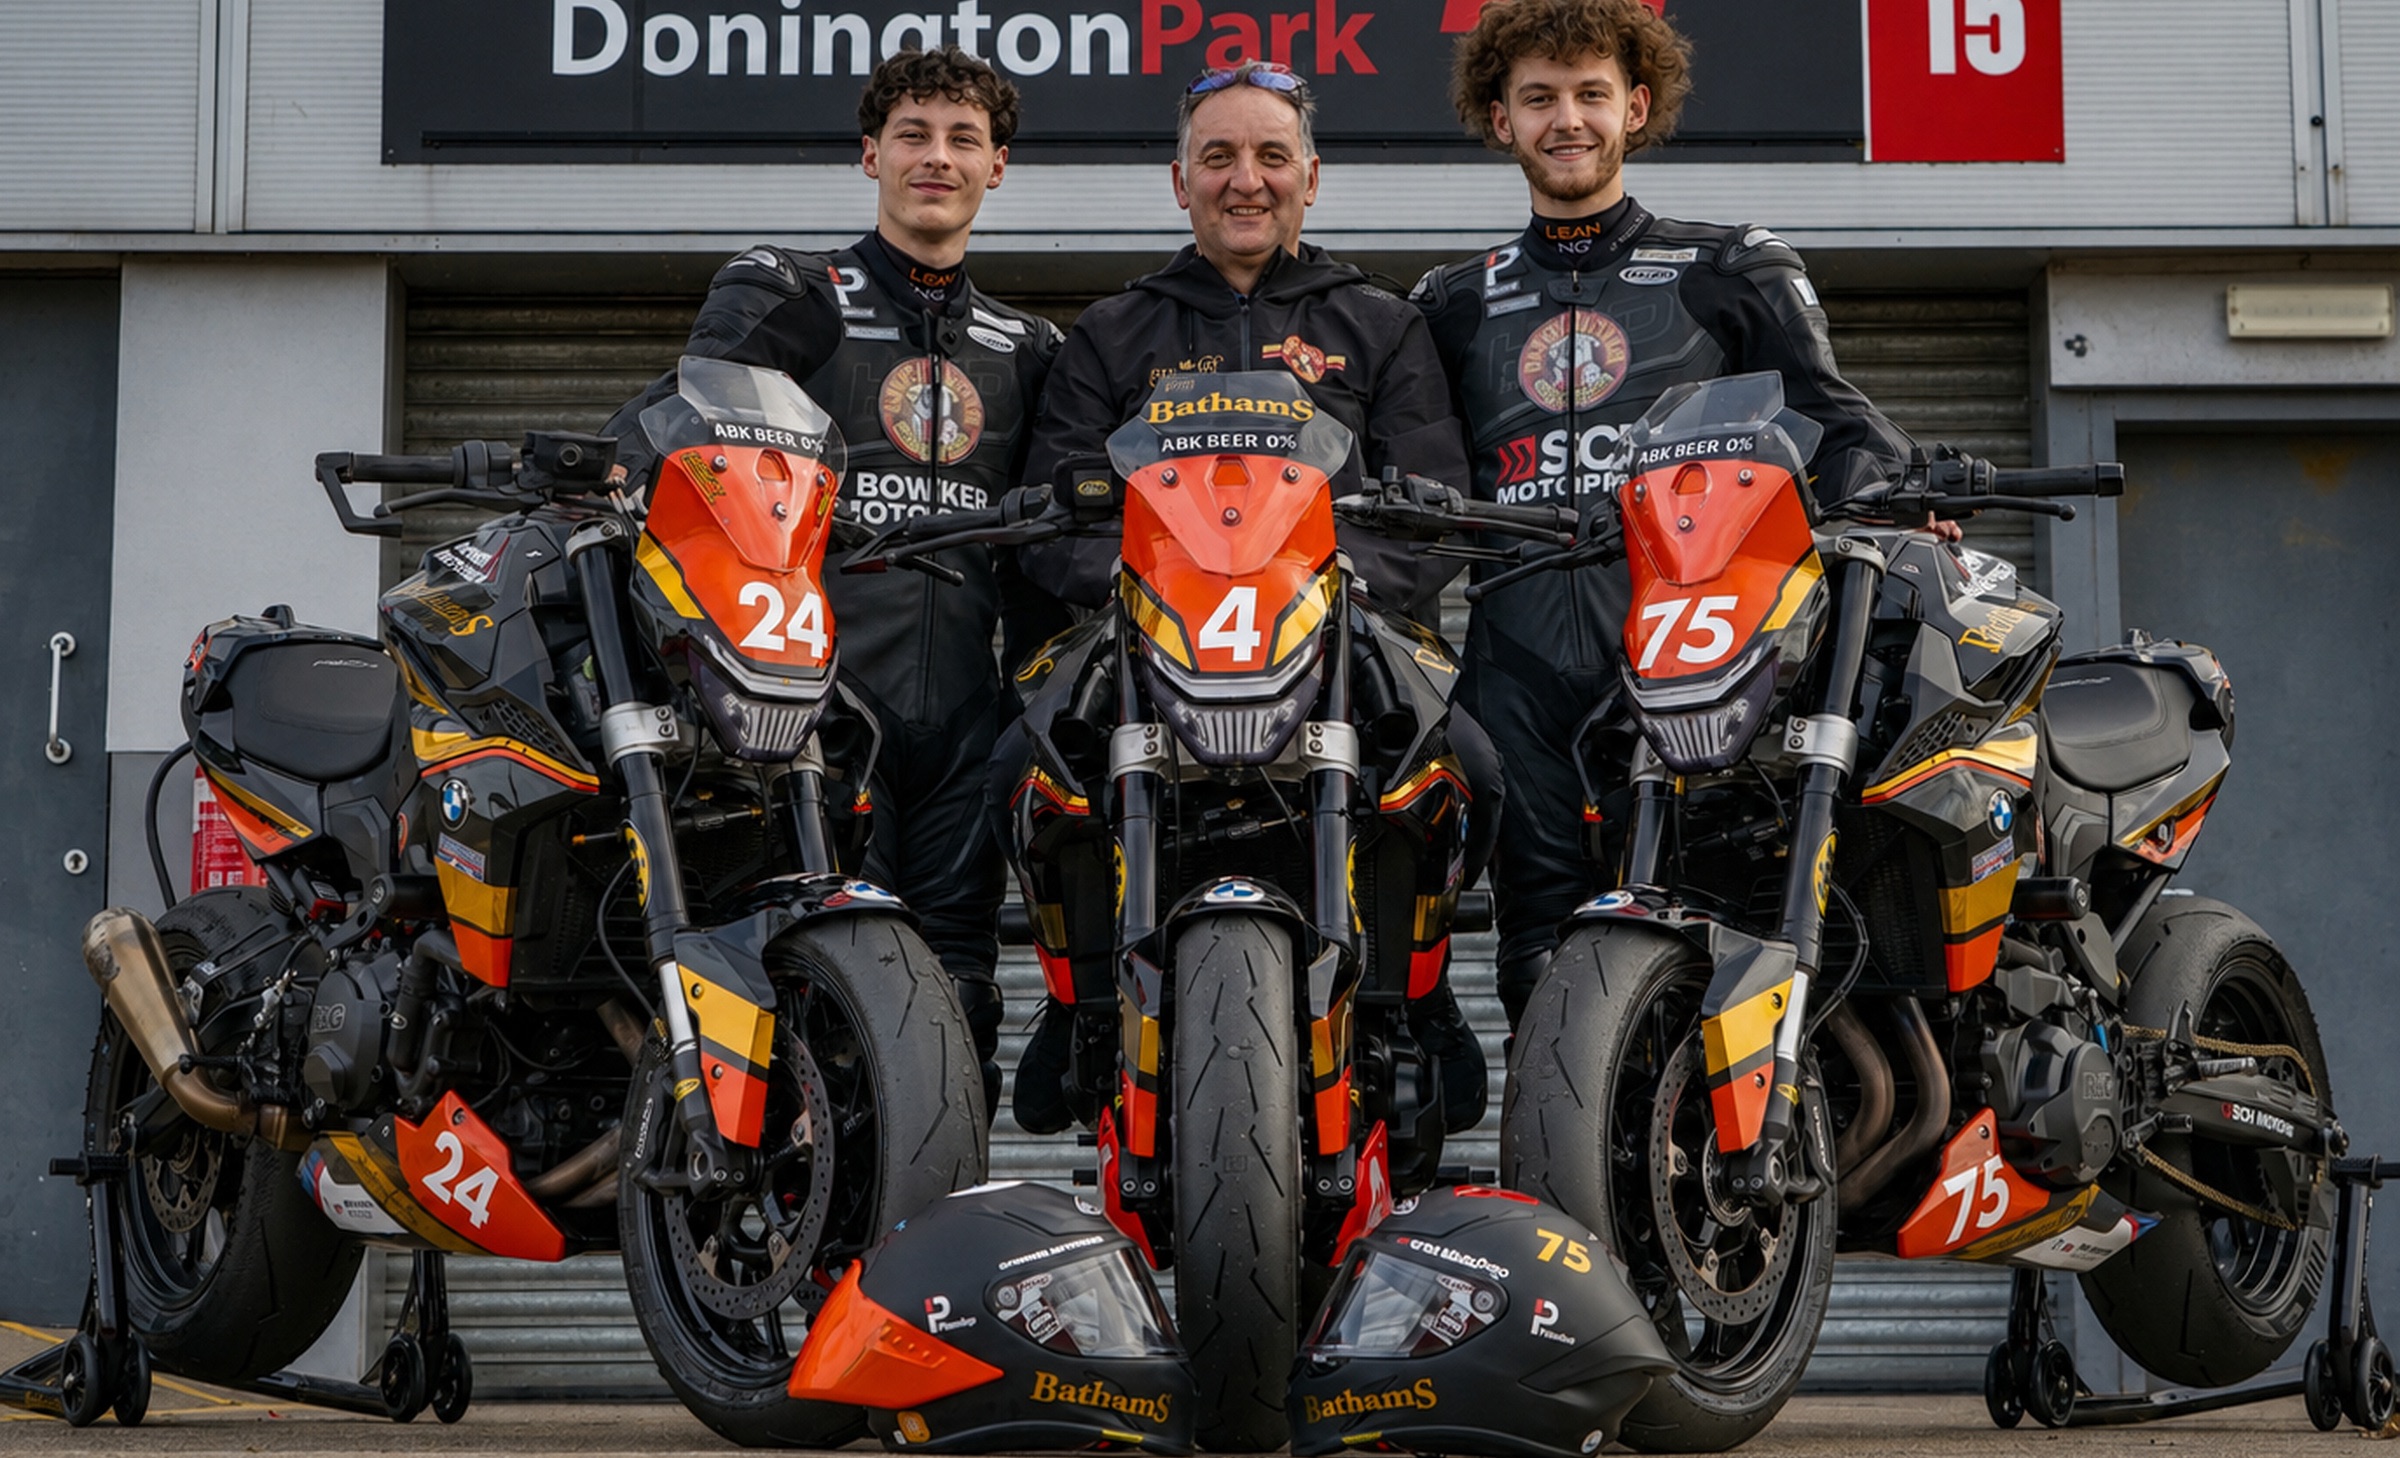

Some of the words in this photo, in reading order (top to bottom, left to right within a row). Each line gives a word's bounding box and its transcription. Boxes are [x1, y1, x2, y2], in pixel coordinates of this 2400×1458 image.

[1545, 222, 1601, 240] LEAN
[714, 423, 752, 441] ABK
[753, 428, 798, 448] BEER
[1161, 433, 1203, 453] ABK
[1207, 433, 1259, 449] BEER
[1266, 435, 1298, 451] 0%
[1637, 445, 1673, 466] ABK
[1674, 438, 1720, 459] BEER
[1726, 436, 1754, 452] 0%
[738, 580, 829, 659] 24
[1199, 586, 1262, 663] 4
[1637, 595, 1740, 671] 75
[422, 1130, 500, 1230] 24
[1942, 1154, 2011, 1246] 75
[1535, 1228, 1593, 1274] 75
